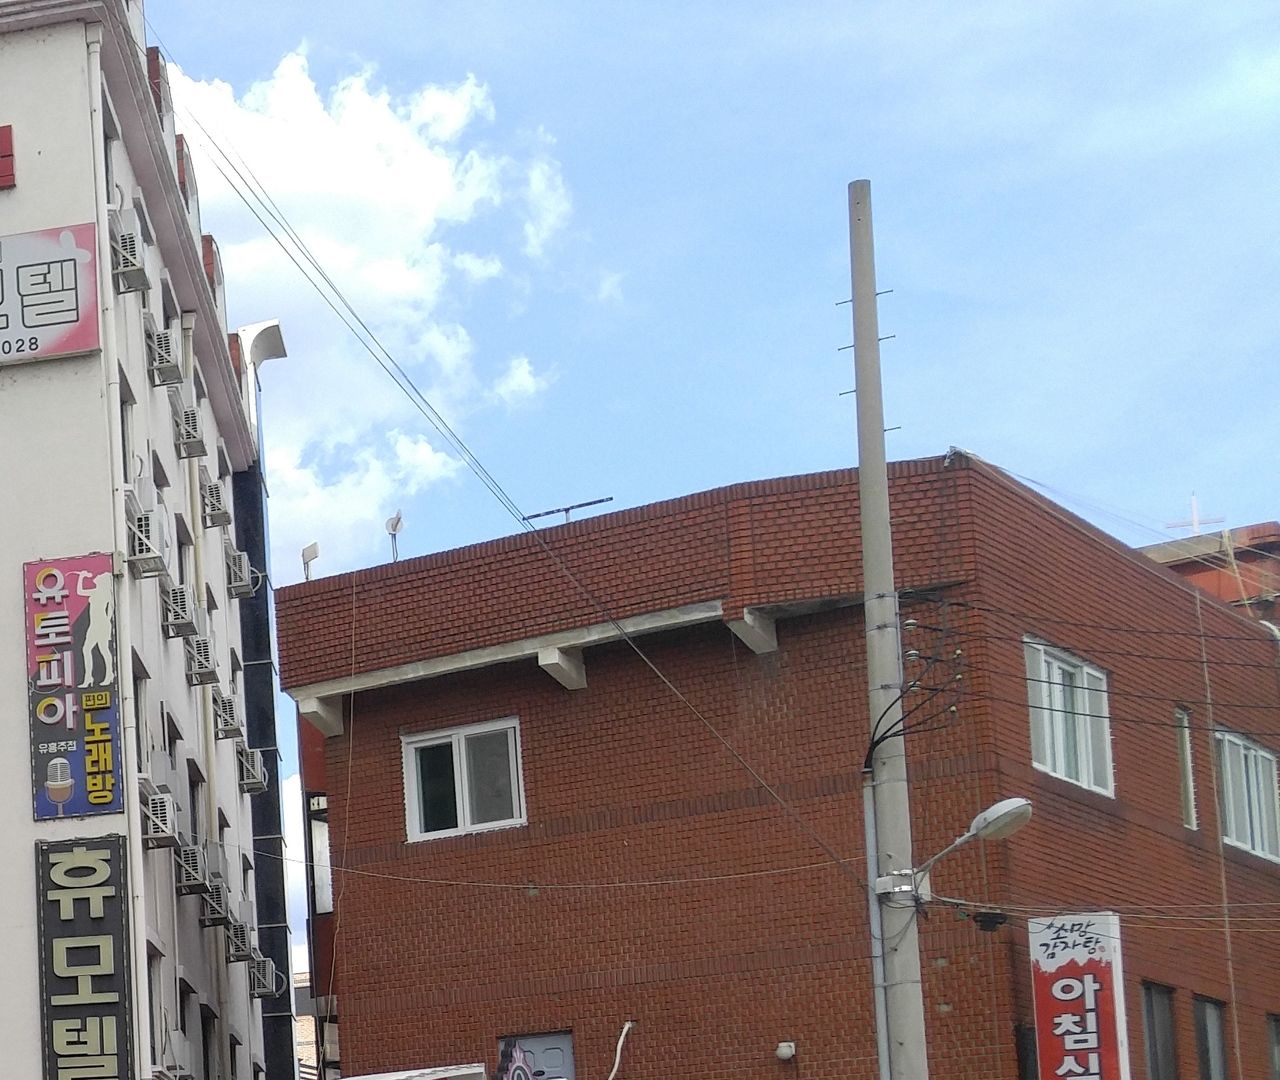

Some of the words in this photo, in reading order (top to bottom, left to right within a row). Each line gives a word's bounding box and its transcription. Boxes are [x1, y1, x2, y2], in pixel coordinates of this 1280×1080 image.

[32, 567, 79, 731] 유토피아
[38, 740, 78, 755] 유흥주점
[84, 711, 116, 806] 노래방
[1039, 936, 1102, 960] 감자탕
